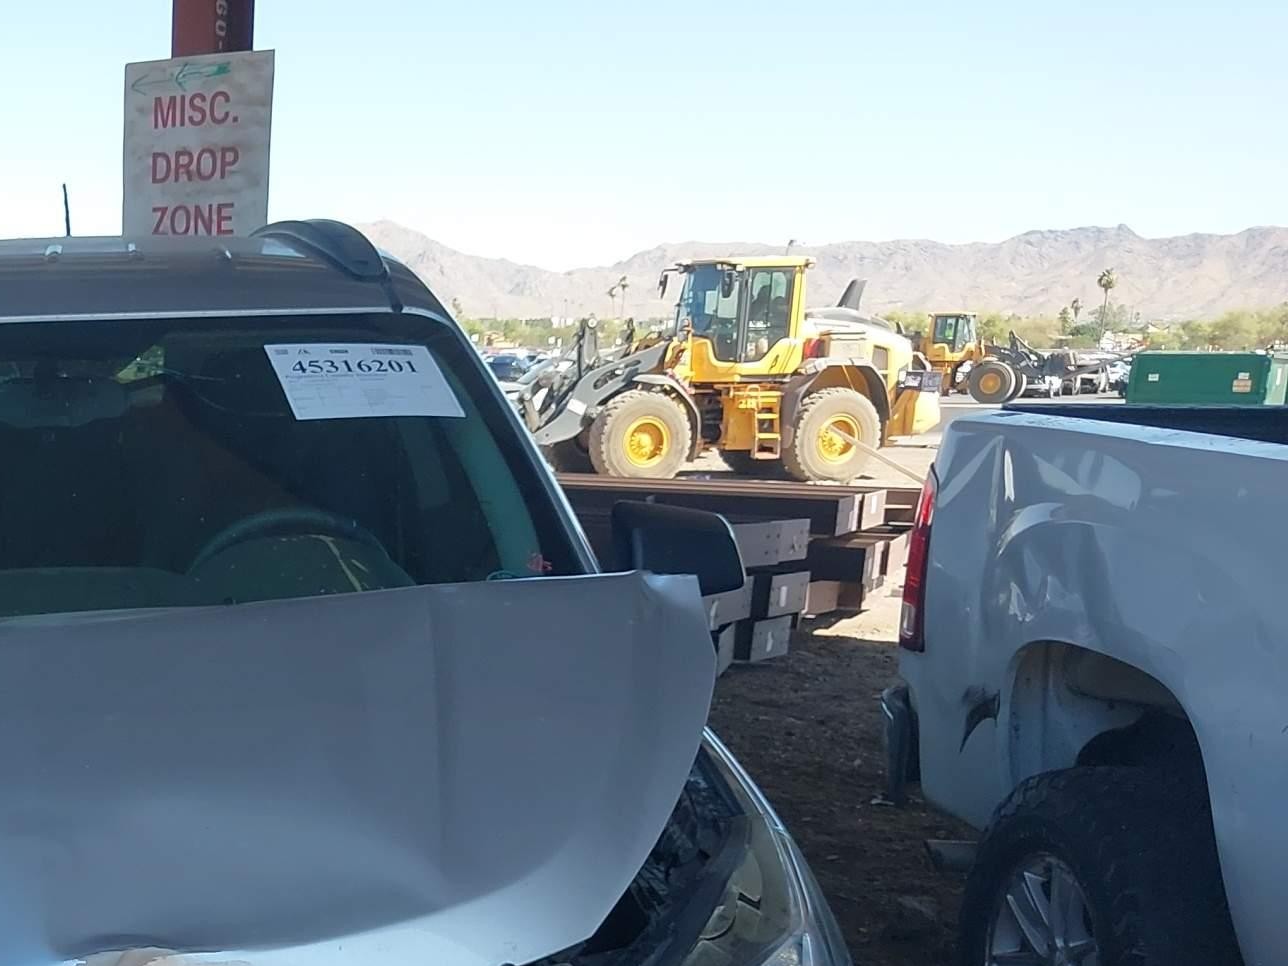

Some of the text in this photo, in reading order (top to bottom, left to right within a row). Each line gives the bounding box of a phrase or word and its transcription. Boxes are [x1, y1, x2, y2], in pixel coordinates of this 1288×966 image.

[153, 90, 239, 130] MISC.
[151, 147, 240, 184] DROP
[152, 202, 235, 236] ZONE
[292, 359, 418, 374] 45316201
